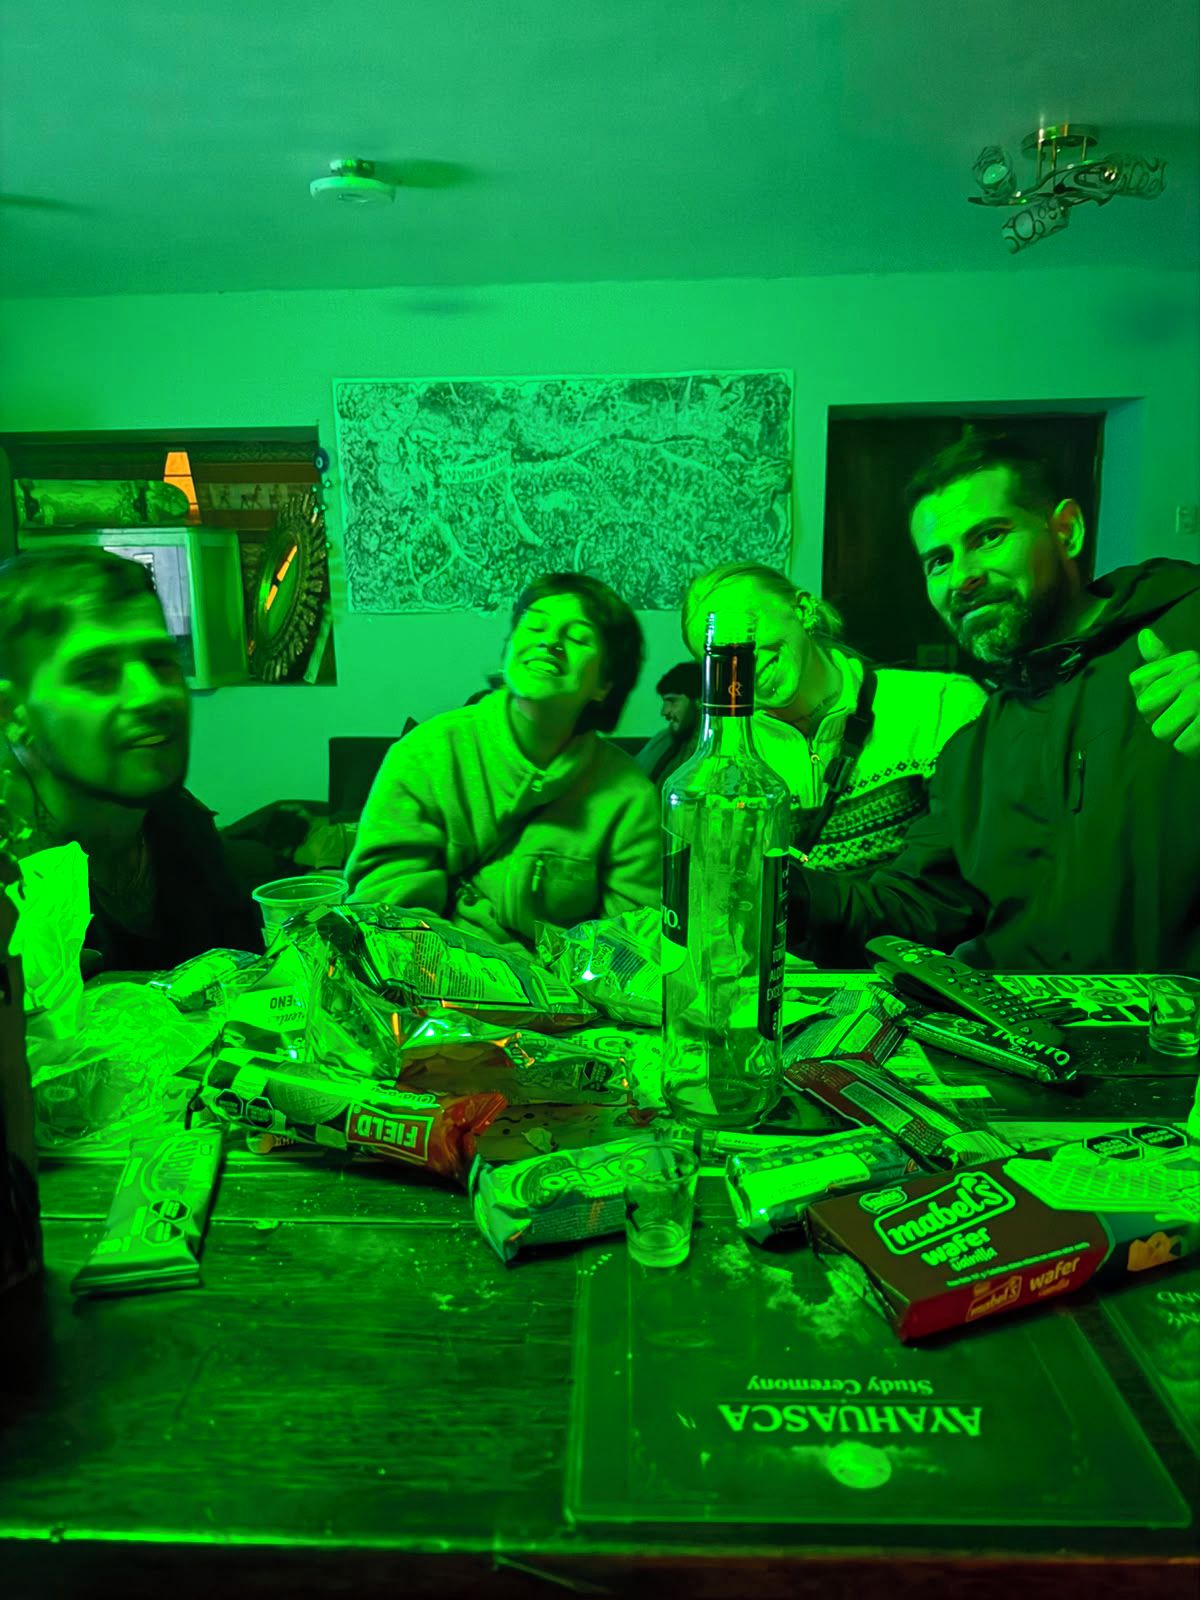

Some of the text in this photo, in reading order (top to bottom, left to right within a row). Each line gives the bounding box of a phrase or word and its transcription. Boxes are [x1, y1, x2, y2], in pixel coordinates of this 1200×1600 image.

[356, 1114, 419, 1149] FIELD
[540, 1156, 646, 1190] OREO
[920, 1227, 993, 1266] wafer
[1029, 1256, 1081, 1293] wafer
[746, 1375, 935, 1396] Study Ceremony
[717, 1403, 983, 1437] AYAHUASCA
